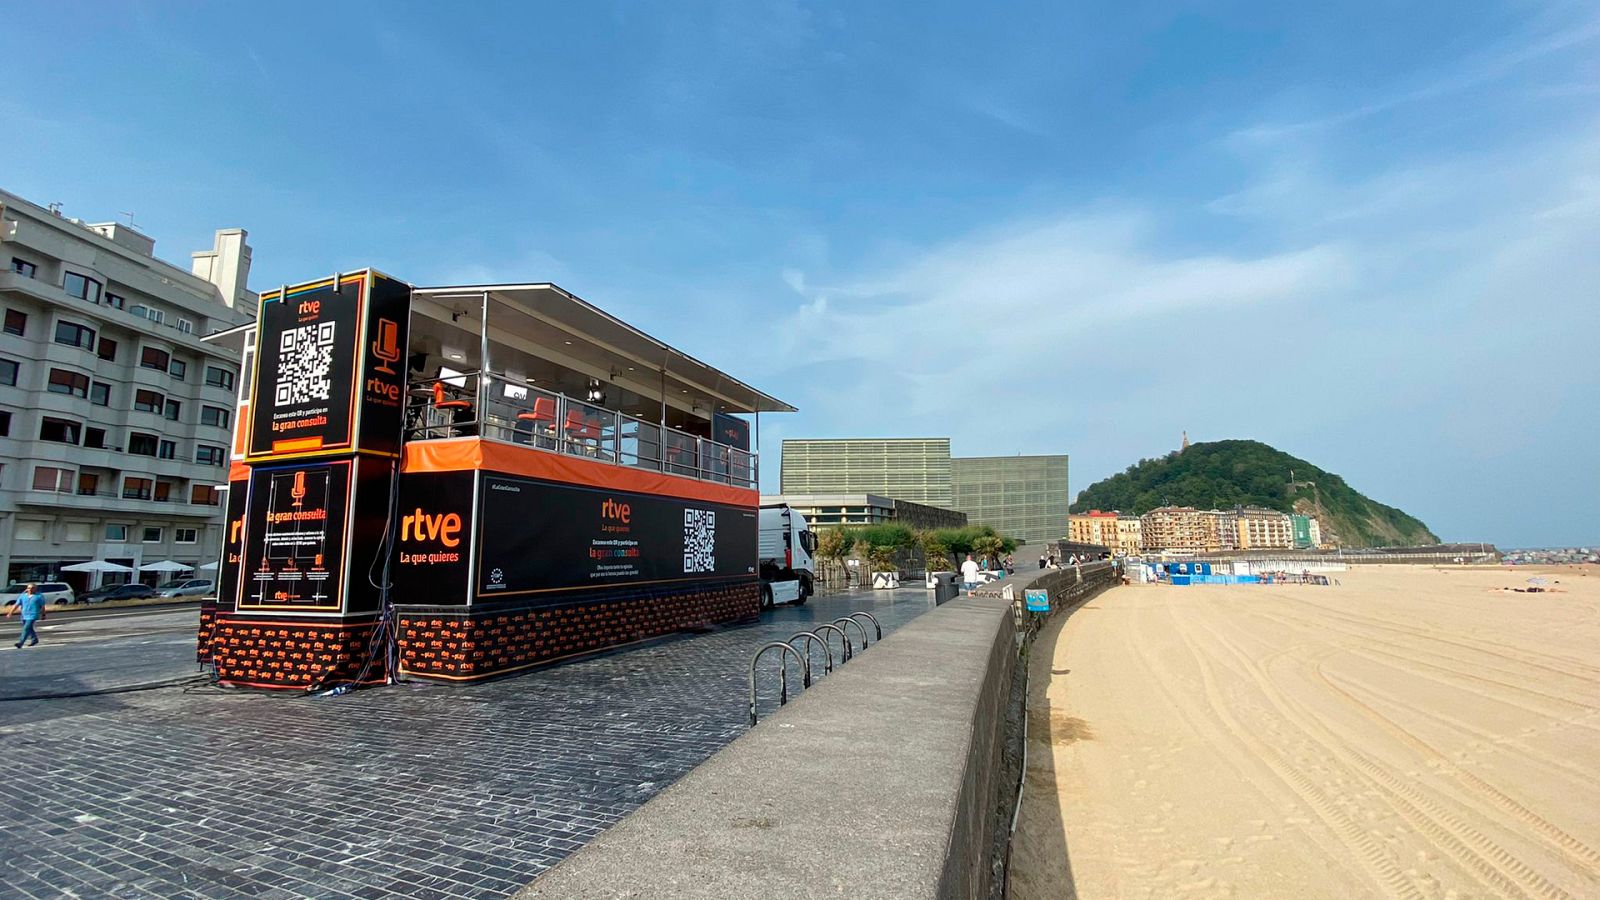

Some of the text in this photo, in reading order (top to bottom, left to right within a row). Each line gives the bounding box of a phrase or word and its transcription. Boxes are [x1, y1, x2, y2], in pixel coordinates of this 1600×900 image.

[298, 300, 320, 314] rtve
[367, 378, 399, 400] rtve
[272, 415, 327, 432] la gran consulta
[275, 512, 292, 524] gran
[293, 509, 326, 521] consulta
[602, 498, 631, 524] rtve
[402, 507, 462, 548] rtve
[400, 551, 459, 565] La que quieres
[590, 547, 640, 560] la gran consulta
